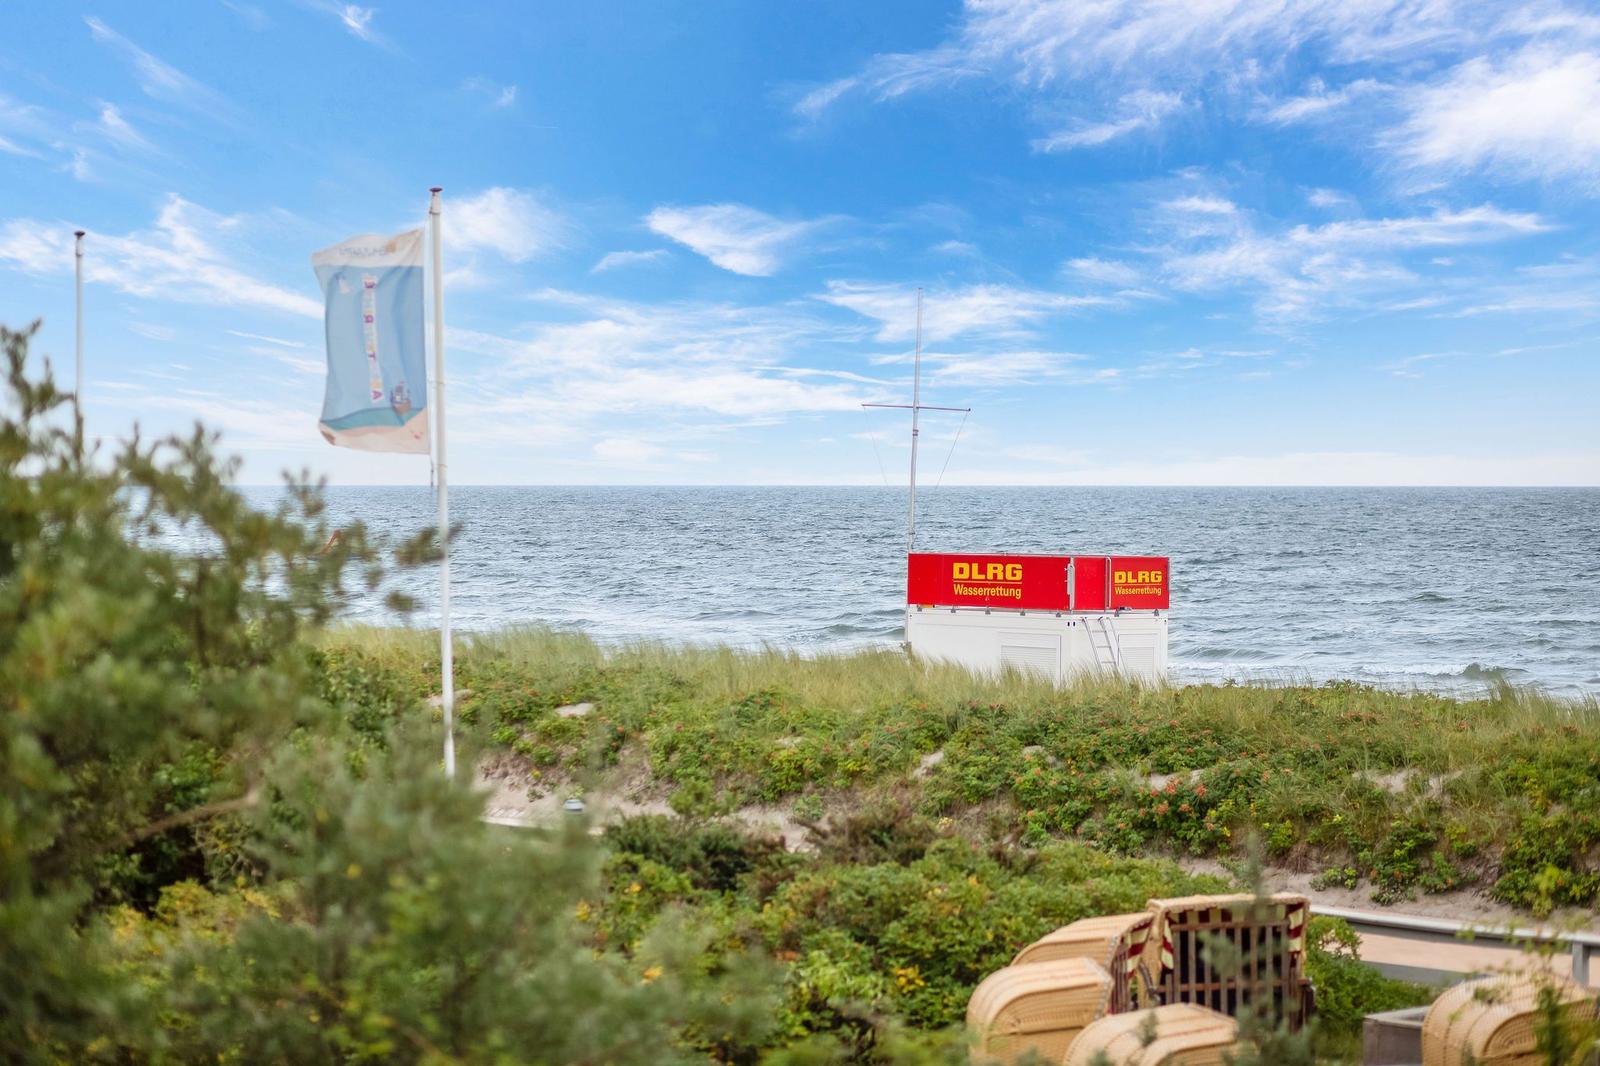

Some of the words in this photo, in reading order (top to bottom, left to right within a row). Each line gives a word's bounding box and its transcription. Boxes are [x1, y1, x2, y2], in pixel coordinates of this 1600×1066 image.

[953, 562, 1023, 580] DLRG
[1114, 571, 1163, 583] DLRG
[953, 583, 1022, 600] Wasserrettung
[1114, 586, 1162, 597] Wasserrettung
